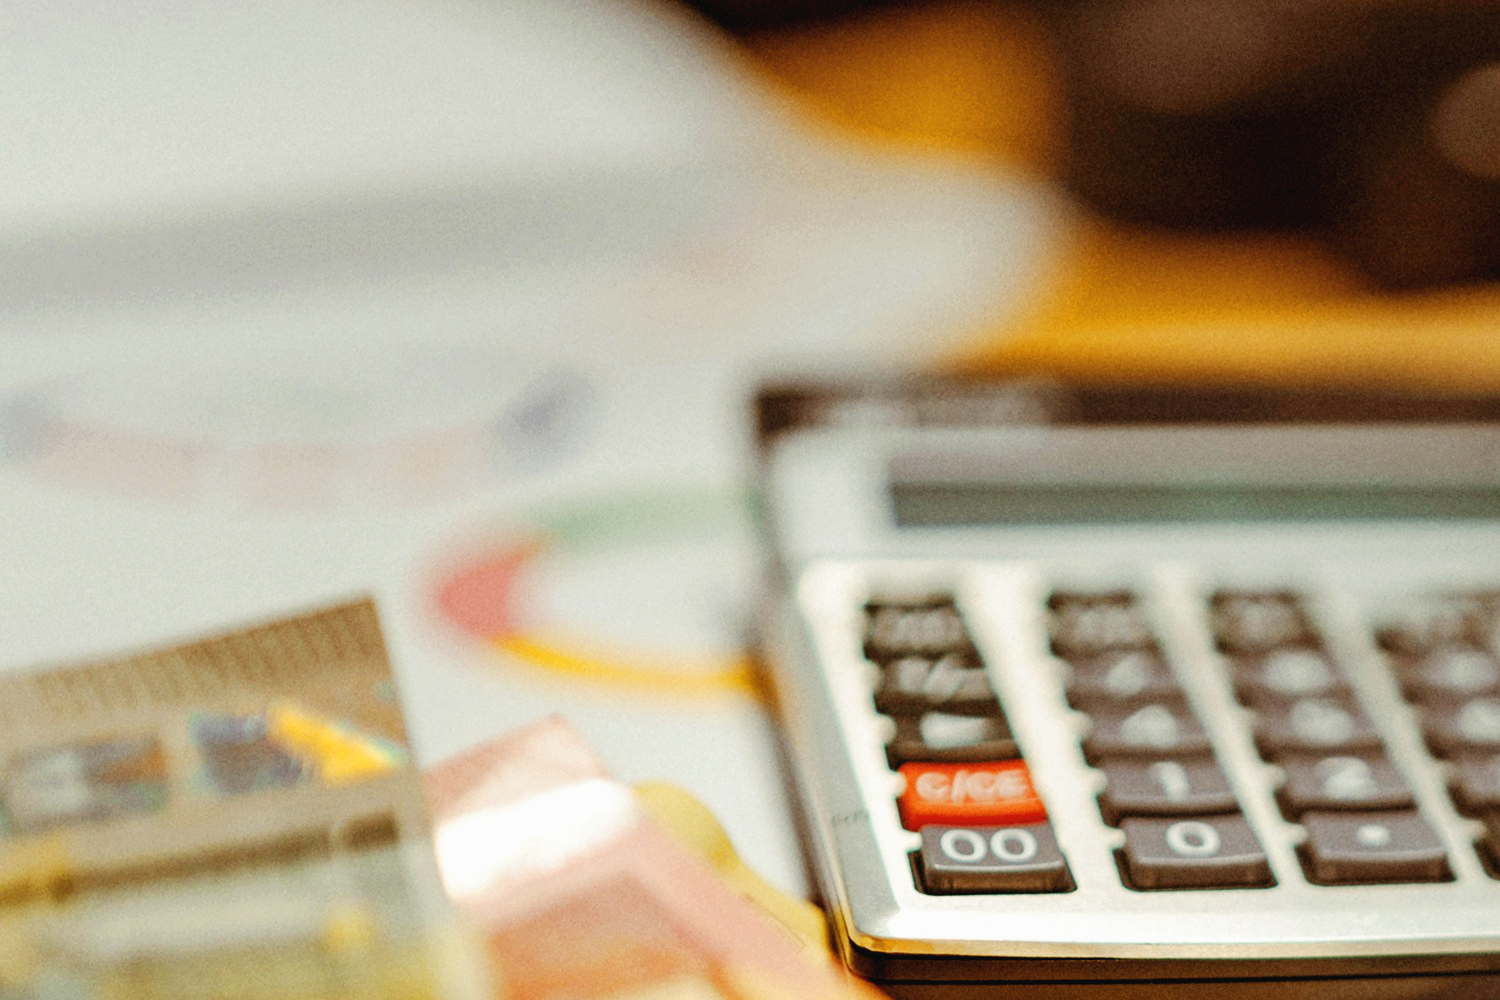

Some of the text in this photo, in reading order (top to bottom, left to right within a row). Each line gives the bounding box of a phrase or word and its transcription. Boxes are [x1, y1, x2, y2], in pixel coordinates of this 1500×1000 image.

[915, 768, 1031, 806] C/CE
[1152, 760, 1190, 799] 1
[940, 827, 1038, 863] 00
[1165, 820, 1222, 857] 0
